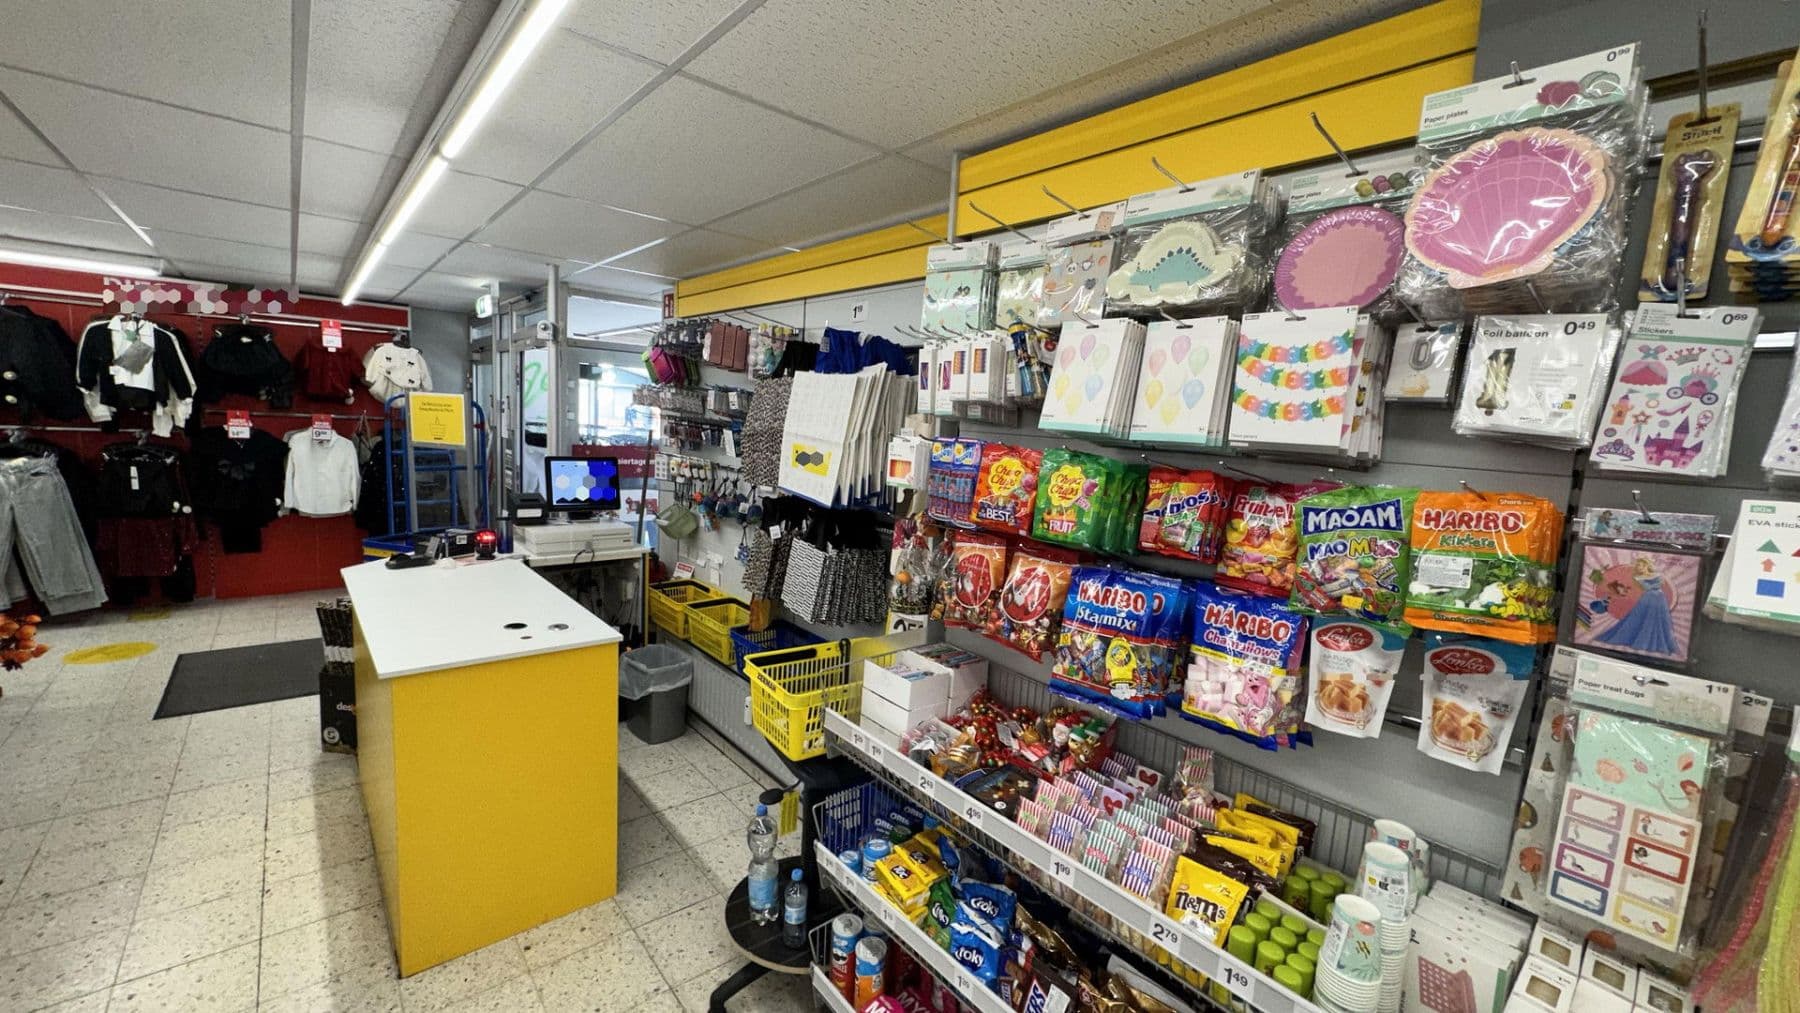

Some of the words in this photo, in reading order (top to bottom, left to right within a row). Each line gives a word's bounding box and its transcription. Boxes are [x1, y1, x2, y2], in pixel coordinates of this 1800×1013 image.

[1424, 116, 1445, 124] Paper
[1446, 109, 1469, 120] plates
[1721, 313, 1748, 325] 069
[1482, 330, 1503, 338] Foil
[1563, 320, 1597, 336] 049
[1638, 326, 1674, 335] Stickers
[986, 507, 1011, 521] BEST
[1308, 505, 1397, 532] MAOAM
[1422, 508, 1523, 535] HARIBO
[1049, 519, 1076, 533] FRUIT
[1077, 580, 1147, 616] HARIBO
[1077, 605, 1133, 631] Starmix
[1204, 603, 1292, 643] HARIBO
[1578, 679, 1602, 688] Paper
[1603, 684, 1623, 693] treat
[1624, 688, 1645, 698] bags
[1705, 684, 1729, 694] 119
[1742, 695, 1768, 706] 299
[1054, 861, 1071, 876] 199
[1153, 922, 1178, 944] 279
[1224, 966, 1249, 988] 149
